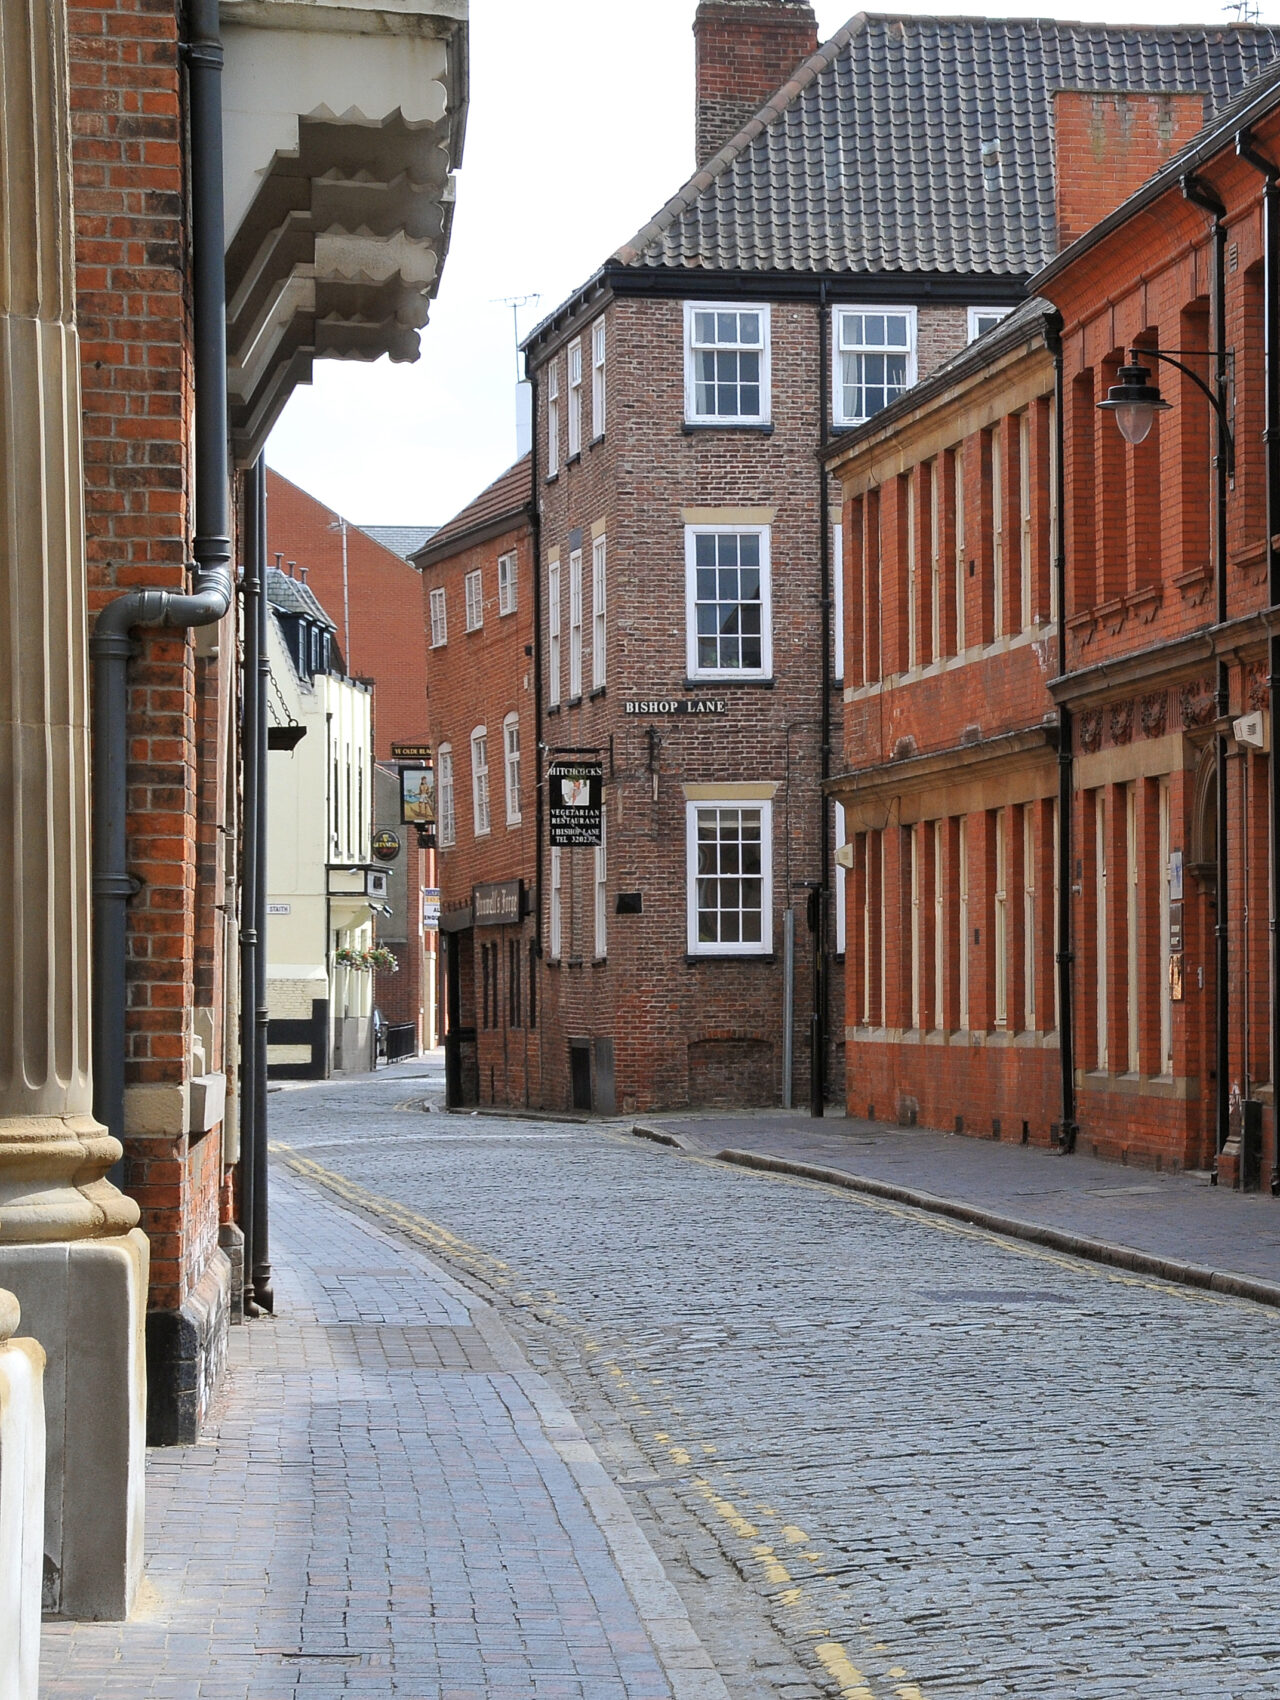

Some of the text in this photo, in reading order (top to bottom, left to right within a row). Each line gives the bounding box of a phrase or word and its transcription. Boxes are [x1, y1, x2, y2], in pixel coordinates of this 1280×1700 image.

[625, 701, 725, 713] BISHOP LANE
[551, 817, 600, 825] RESTAURANT
